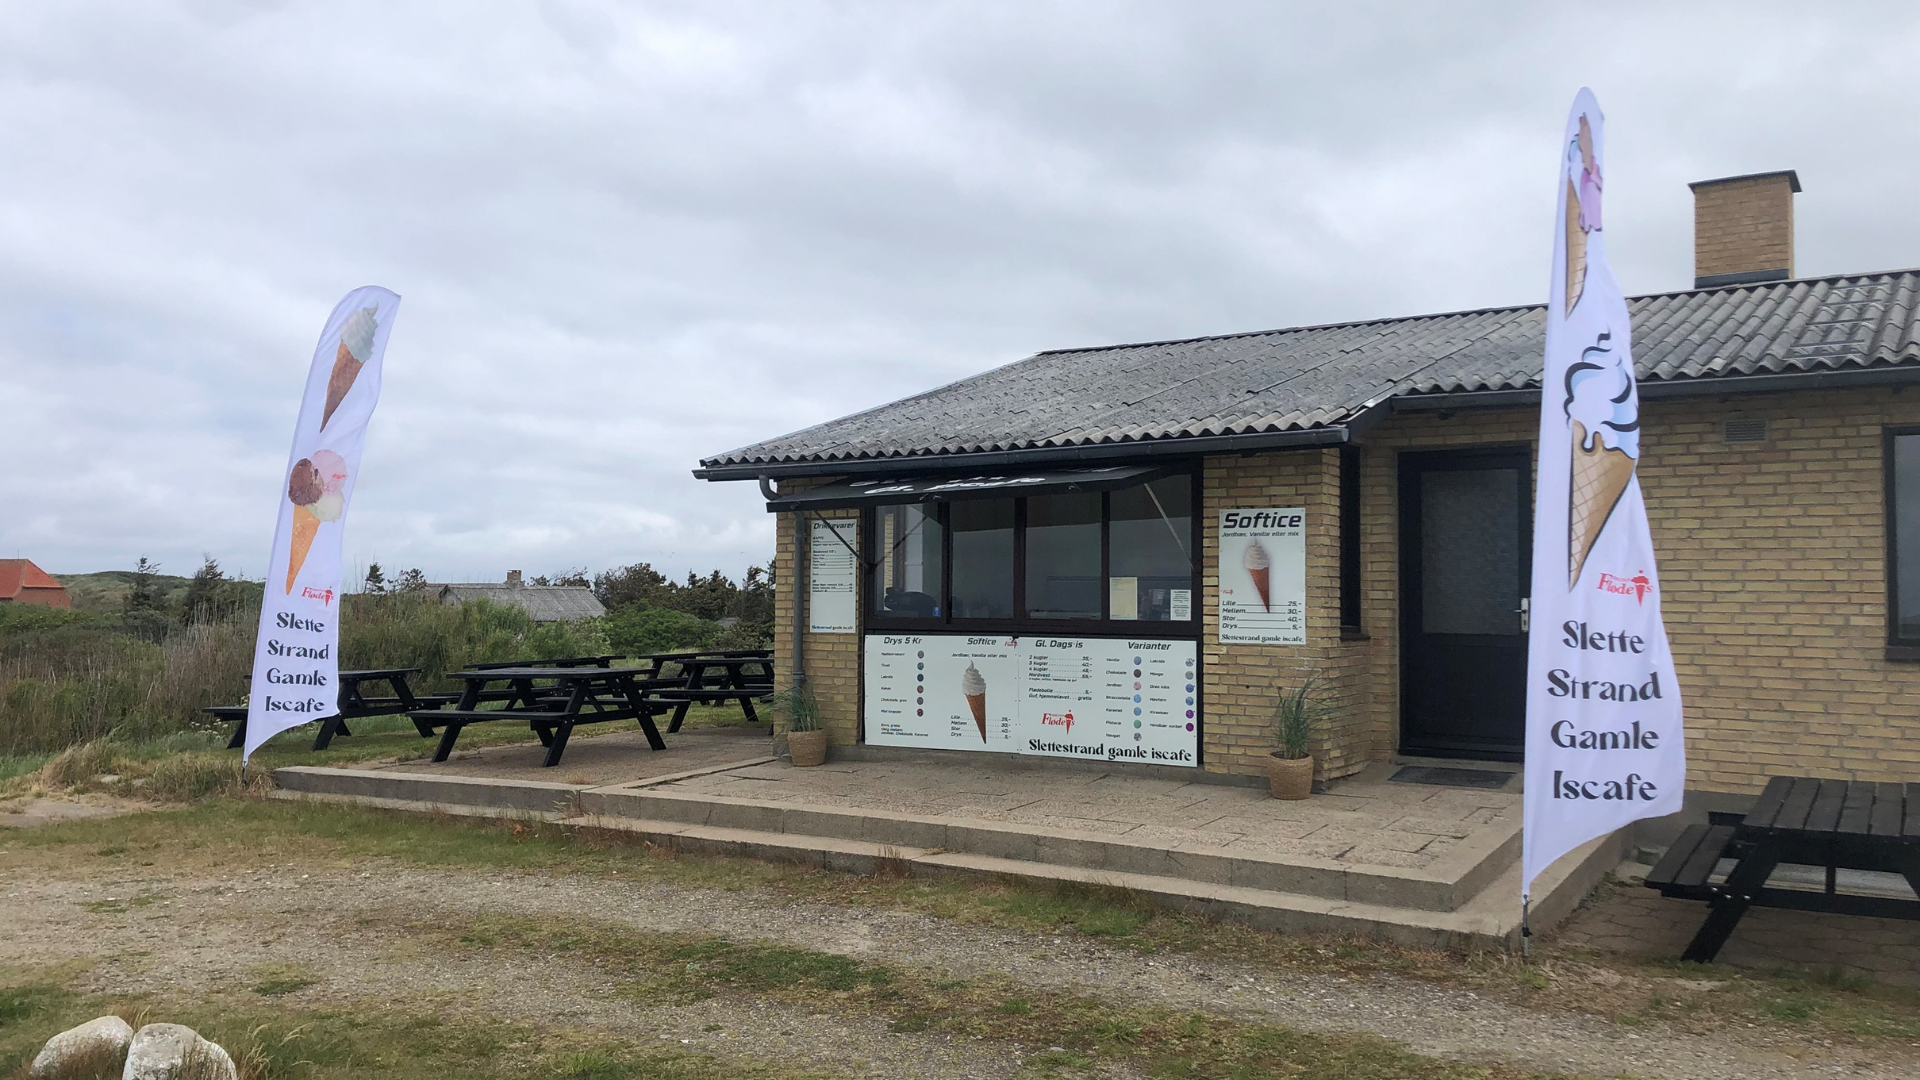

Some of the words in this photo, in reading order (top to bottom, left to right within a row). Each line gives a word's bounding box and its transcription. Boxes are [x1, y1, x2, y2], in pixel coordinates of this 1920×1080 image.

[1223, 512, 1302, 528] Softice
[276, 612, 325, 633] Slette
[884, 636, 902, 646] Drys
[967, 638, 997, 646] Softice
[1036, 640, 1047, 648] Gl.
[1050, 640, 1073, 649] Dags
[1128, 642, 1172, 650] Varianter
[1262, 634, 1281, 642] gamle
[1562, 620, 1646, 654] Slette
[268, 638, 329, 660] Strand
[266, 668, 328, 687] Gamle
[1547, 668, 1663, 702] Strand
[264, 695, 326, 714] Iscafe
[1550, 720, 1660, 750] Gamle
[1028, 738, 1104, 756] Slettestrand
[1108, 744, 1148, 760] gamle
[1151, 748, 1192, 762] iscafe
[1553, 770, 1658, 801] Iscafe
